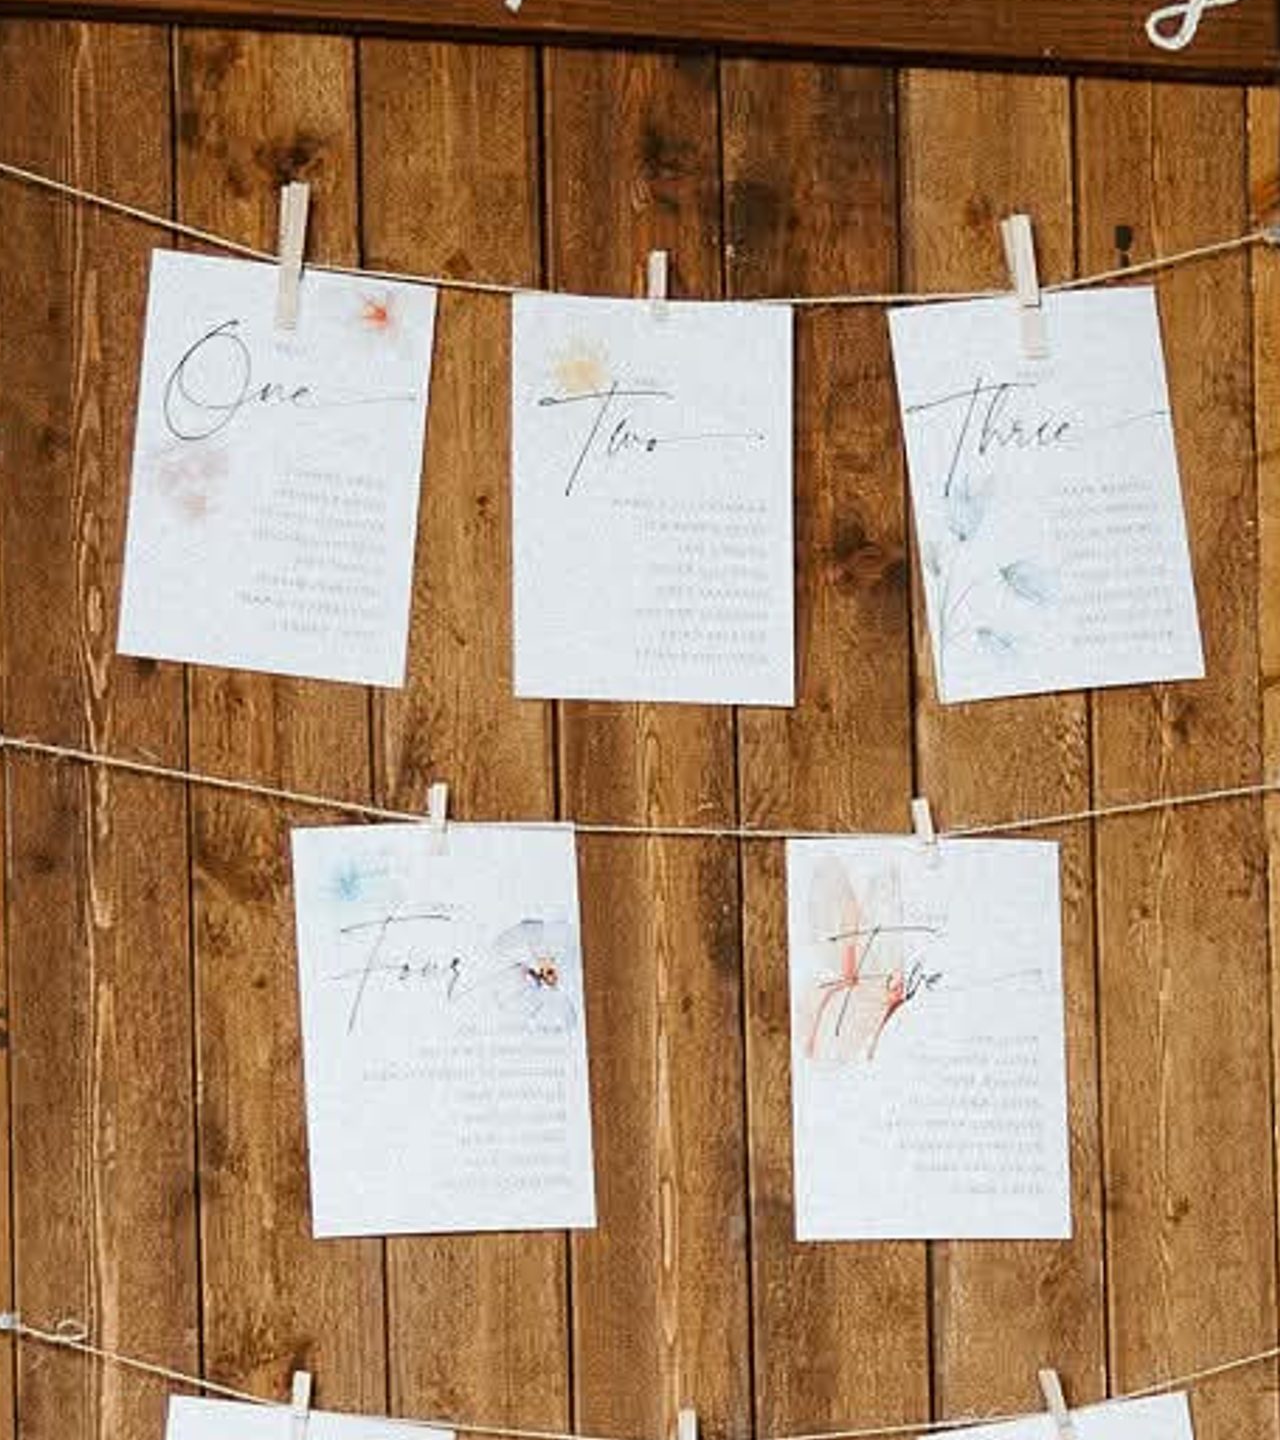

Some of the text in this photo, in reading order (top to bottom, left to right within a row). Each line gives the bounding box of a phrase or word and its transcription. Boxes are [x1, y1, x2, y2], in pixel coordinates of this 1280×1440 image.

[162, 319, 417, 441] One
[537, 380, 766, 497] Two
[905, 375, 1168, 497] Three
